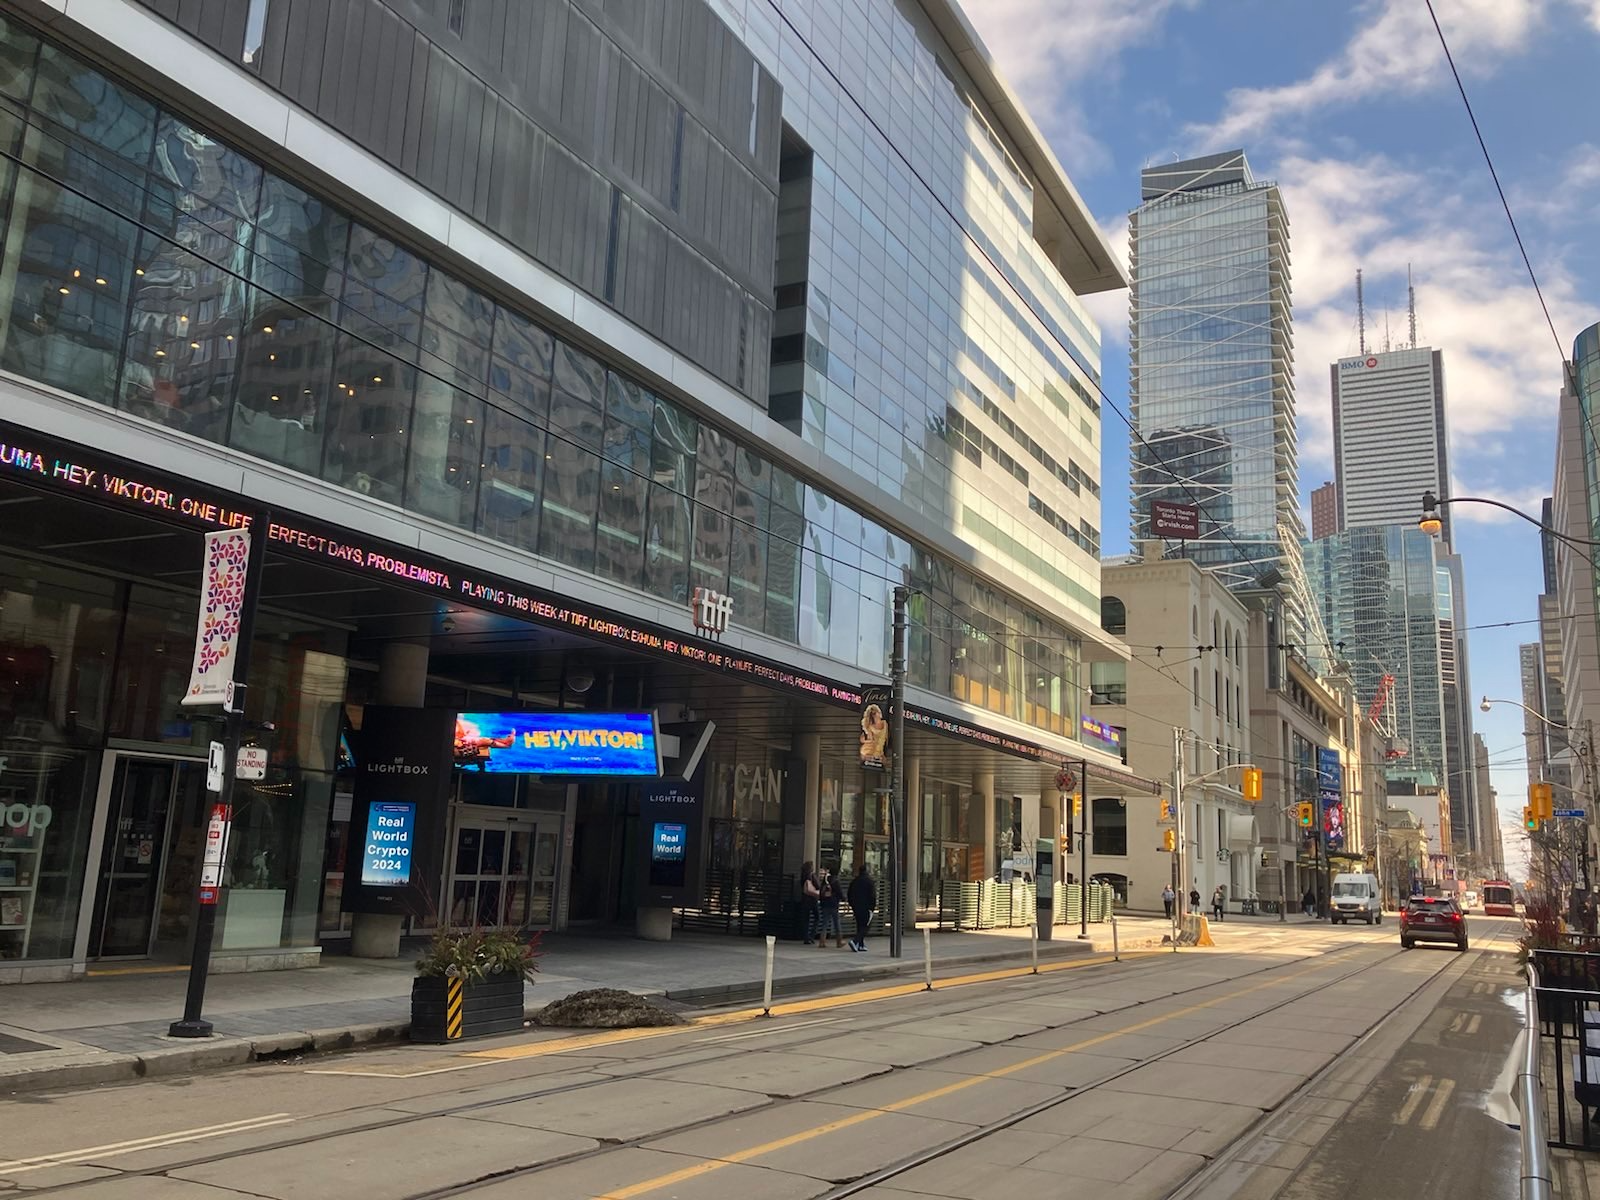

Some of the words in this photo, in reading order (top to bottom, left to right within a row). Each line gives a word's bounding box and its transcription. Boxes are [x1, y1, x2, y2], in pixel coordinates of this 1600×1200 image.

[1341, 360, 1365, 369] BMO
[1156, 505, 1176, 514] Toronto
[1177, 508, 1196, 517] Theatre
[1161, 512, 1177, 520] Starts
[180, 498, 217, 522] ONE
[268, 523, 326, 553] ERFECT
[461, 580, 504, 604] PLAYING
[506, 593, 529, 611] THIS
[530, 600, 558, 619] WEEK
[558, 609, 569, 622] AT
[570, 612, 589, 628] TIFF
[754, 664, 780, 681] PERFECT
[700, 587, 734, 632] tiff
[247, 750, 257, 759] NO
[236, 759, 266, 769] STANDING
[367, 763, 429, 775] LIGHTBOX
[649, 795, 696, 804] LIGHTBOX
[378, 816, 404, 827] Real
[371, 830, 408, 842] World
[660, 833, 679, 843] Real
[367, 845, 410, 858] Crypto
[656, 844, 682, 853] World
[371, 859, 402, 870] 2024
